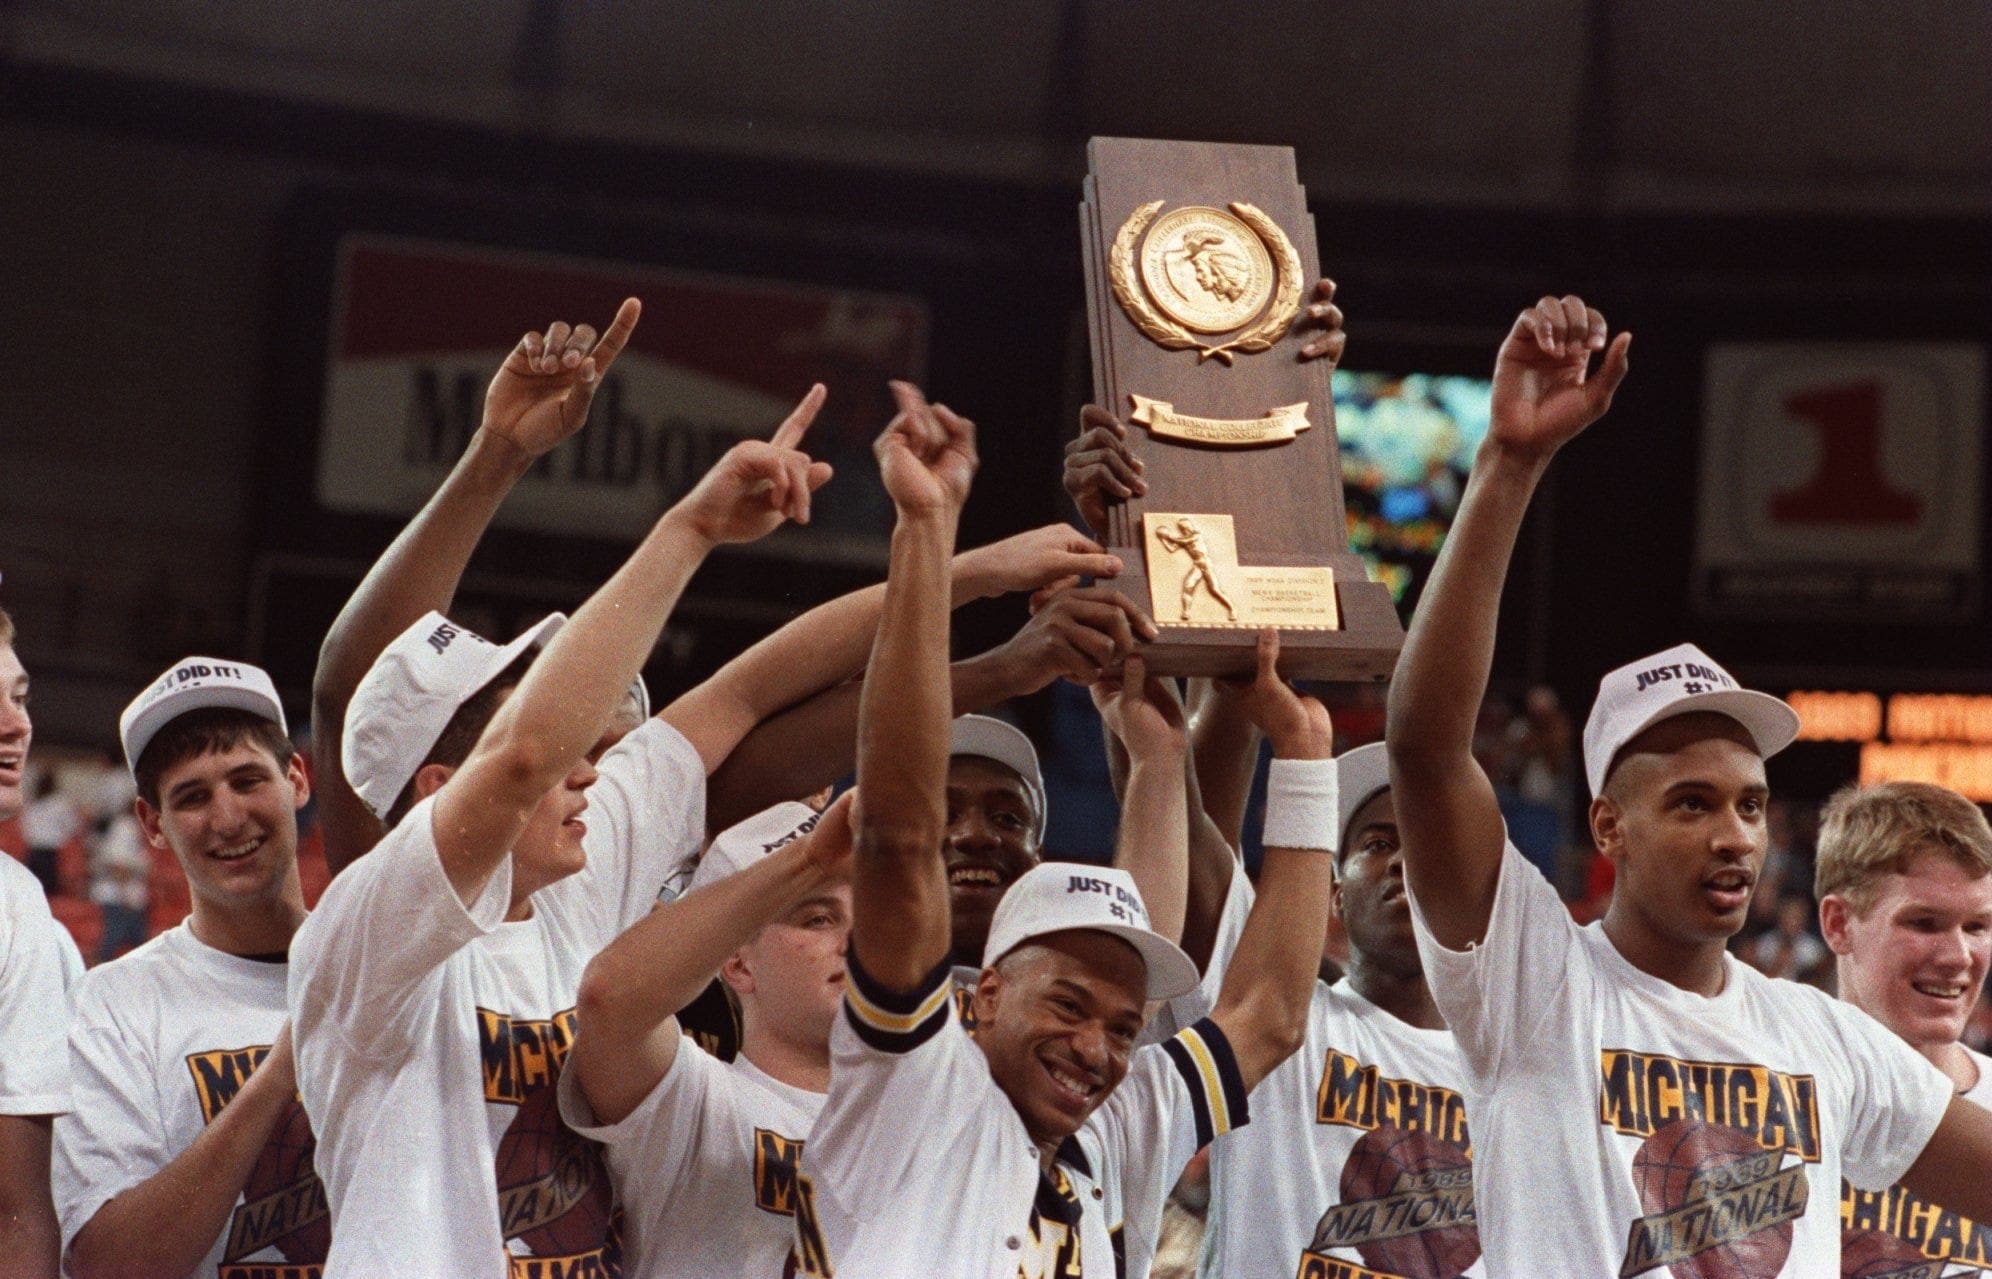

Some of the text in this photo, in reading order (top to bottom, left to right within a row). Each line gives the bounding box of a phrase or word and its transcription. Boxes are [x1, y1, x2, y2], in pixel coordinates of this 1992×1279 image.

[1771, 380, 1920, 523] 1
[176, 664, 211, 682] DID
[1636, 663, 1683, 691] JUST
[1685, 663, 1719, 682] DID
[1066, 876, 1112, 896] JUST
[1322, 1055, 1471, 1151] MICHIG
[1602, 1052, 1816, 1157] MICHIGAN
